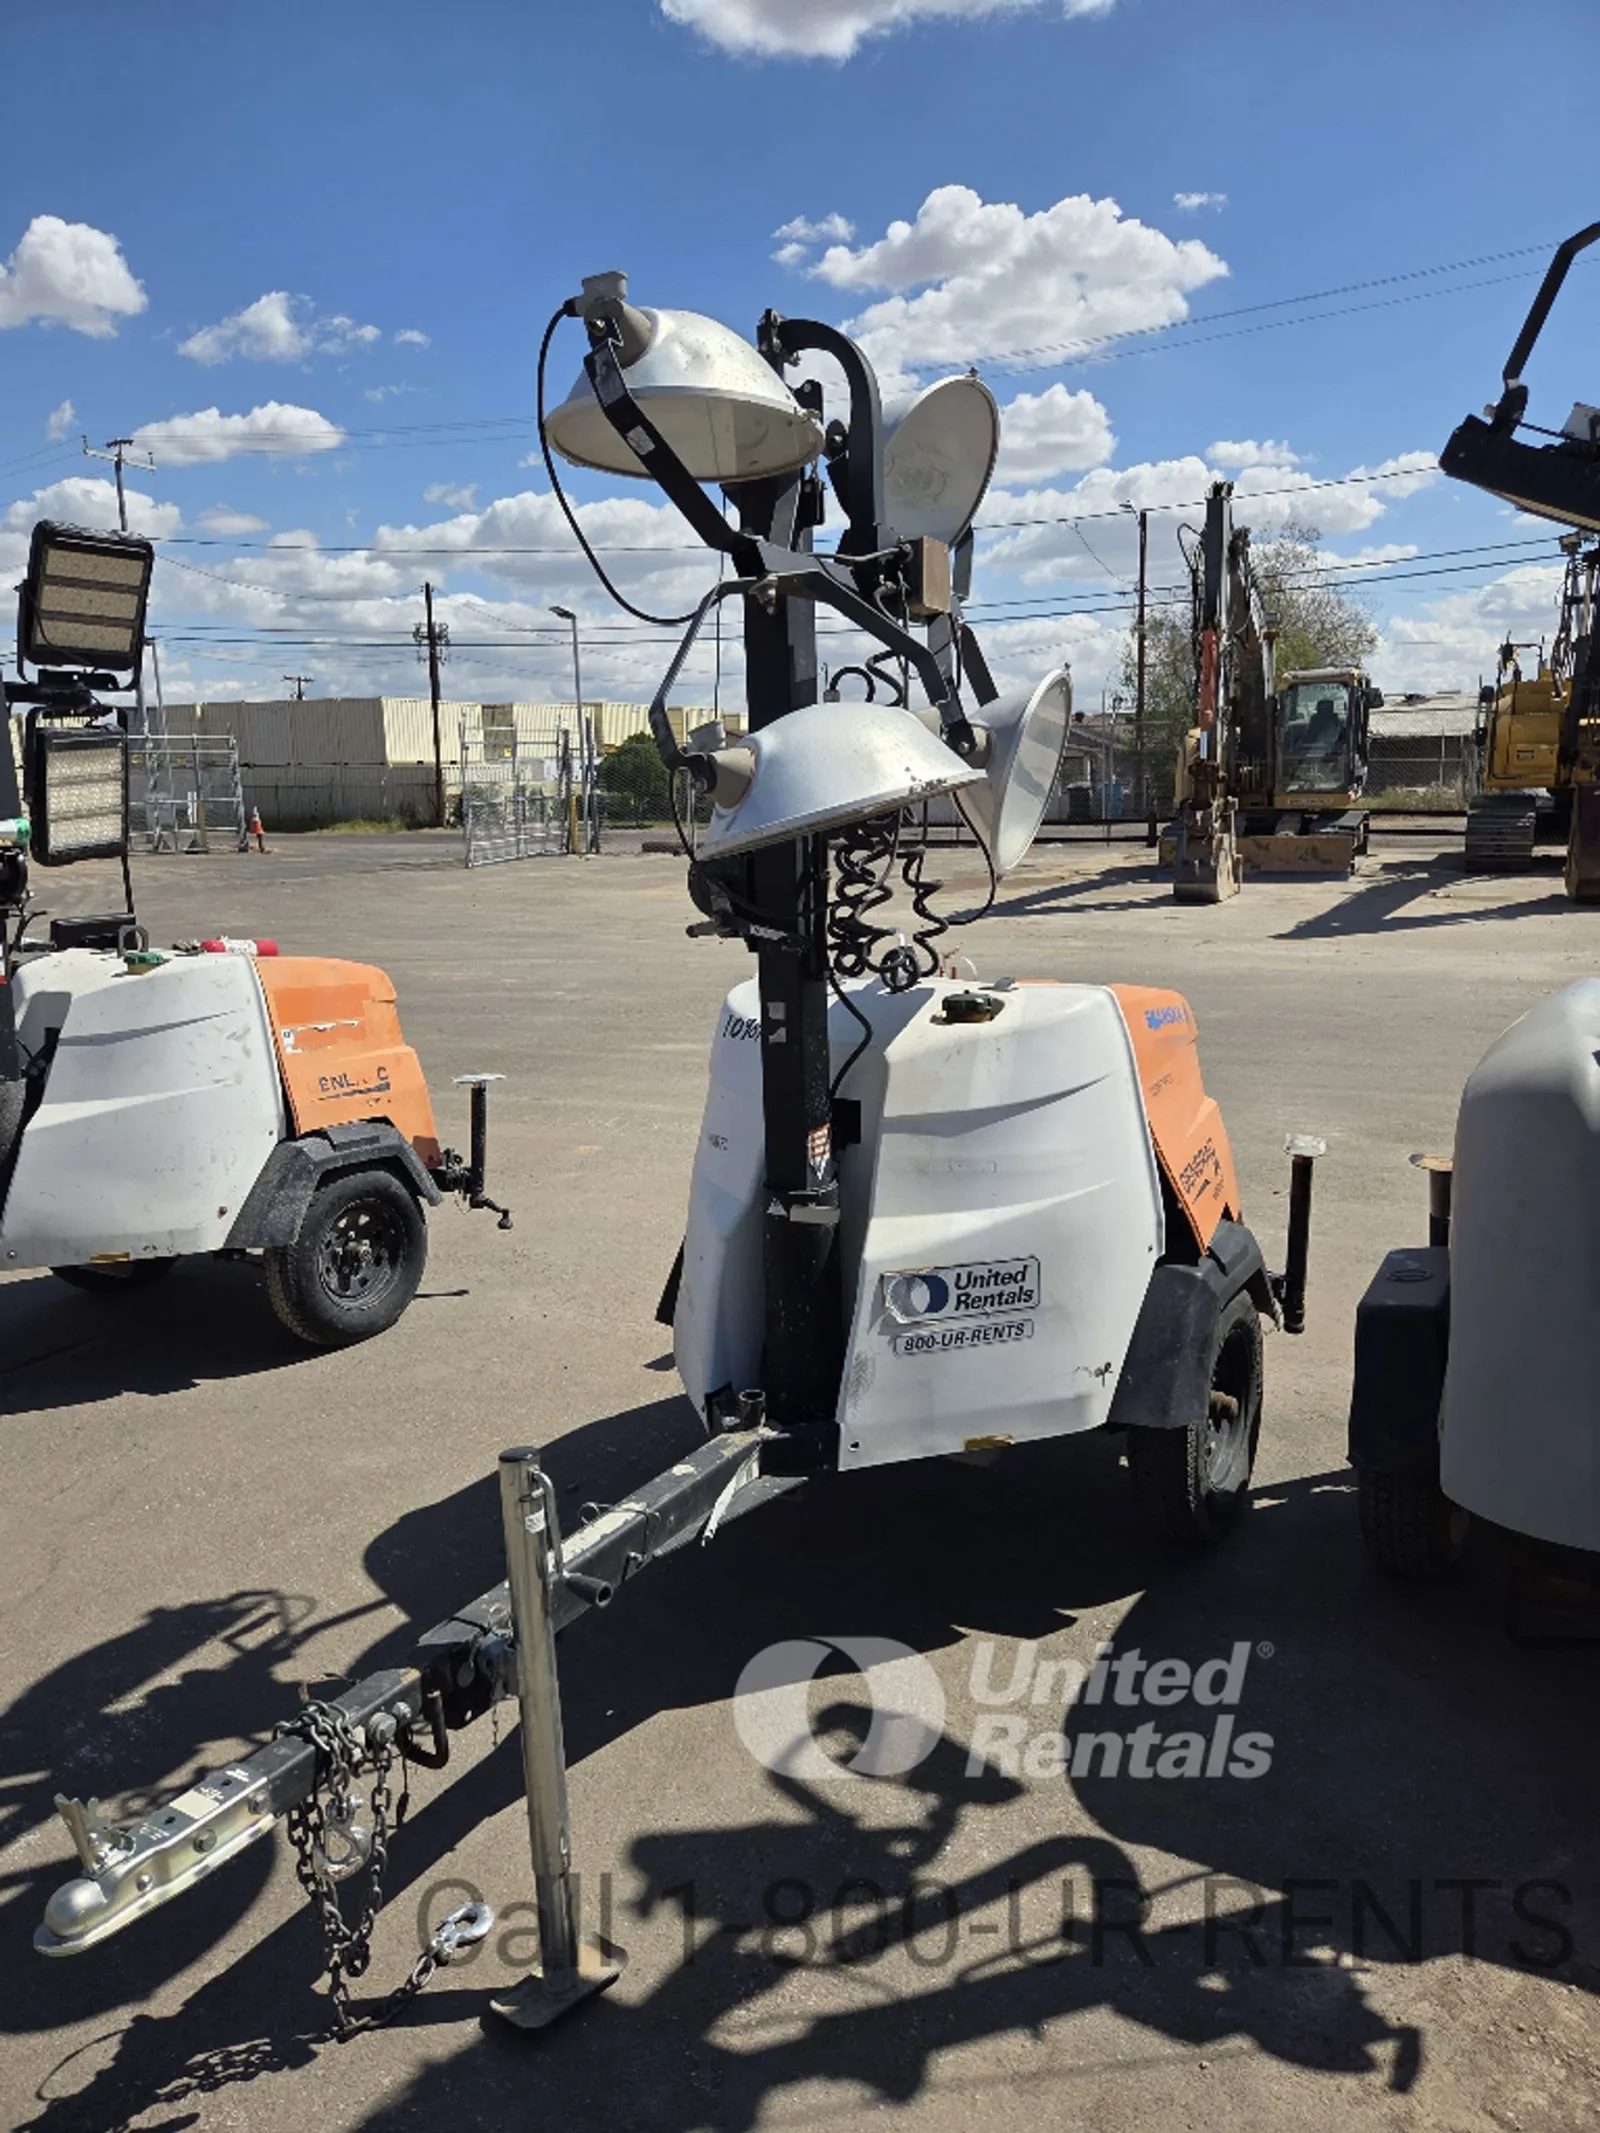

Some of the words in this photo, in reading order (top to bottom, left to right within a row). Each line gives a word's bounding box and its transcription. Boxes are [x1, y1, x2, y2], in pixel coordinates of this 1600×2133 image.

[954, 1264, 1030, 1291] United
[954, 1285, 1035, 1312] Rentals
[904, 1322, 1026, 1351] 800-UR-RENTS
